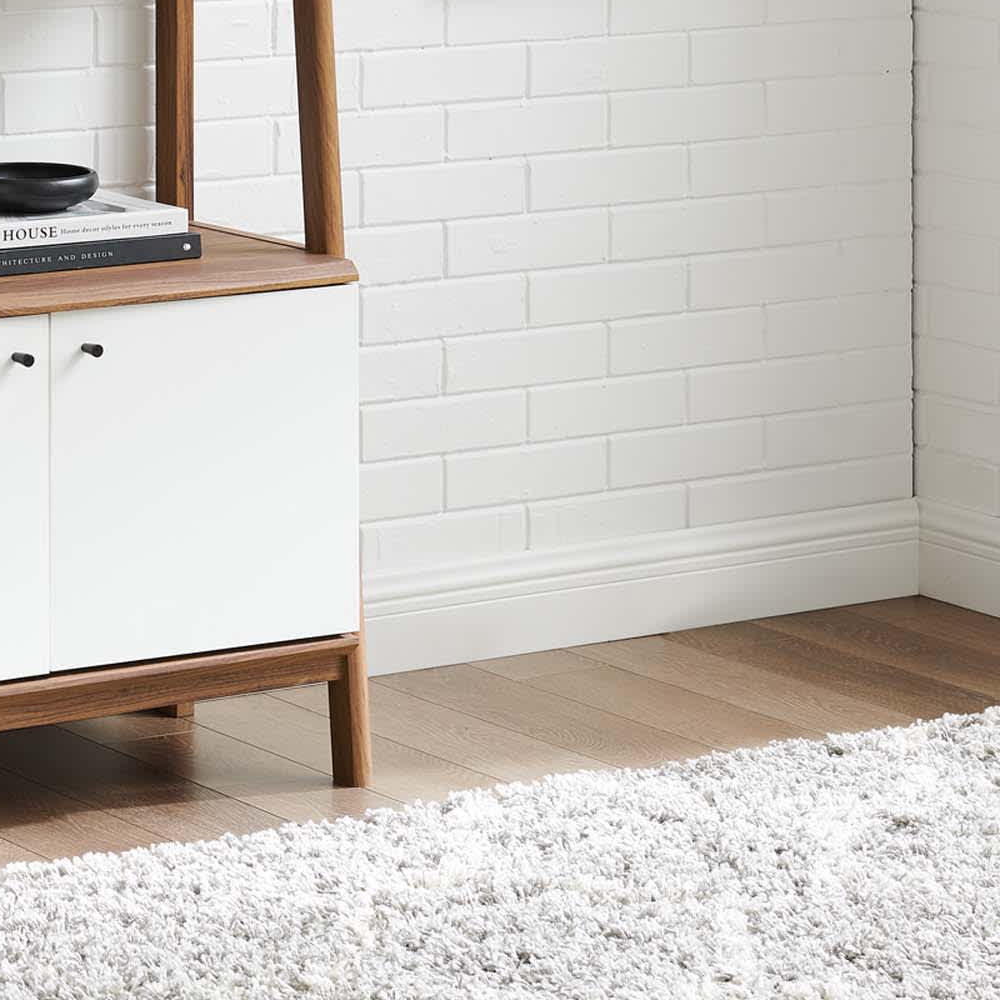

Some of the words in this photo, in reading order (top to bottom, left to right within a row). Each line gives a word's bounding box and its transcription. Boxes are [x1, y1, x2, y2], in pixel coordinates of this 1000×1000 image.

[3, 226, 58, 241] HOUSE
[122, 223, 132, 231] for
[57, 253, 76, 262] AND
[80, 250, 114, 260] DESIGN
